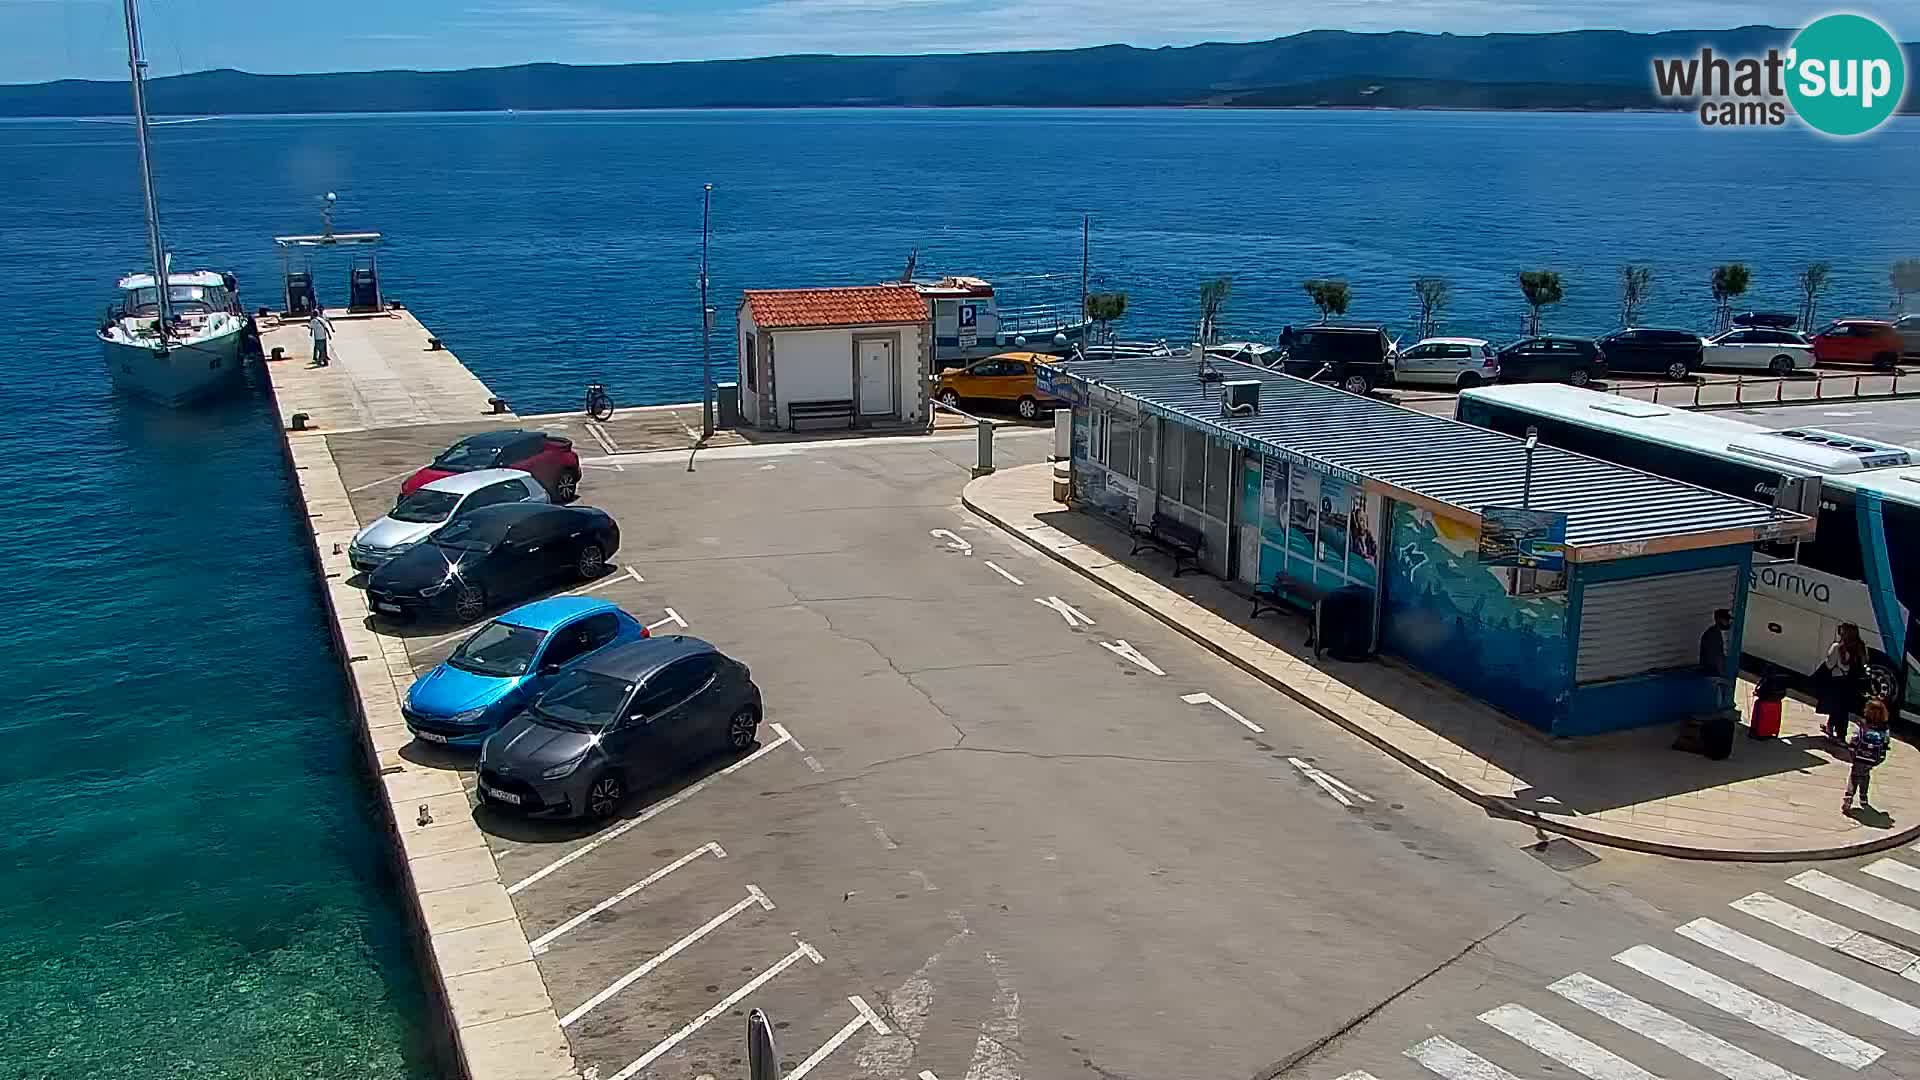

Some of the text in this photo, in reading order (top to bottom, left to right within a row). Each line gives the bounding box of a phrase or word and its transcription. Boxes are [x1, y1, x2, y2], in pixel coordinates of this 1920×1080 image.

[962, 307, 973, 325] P
[1274, 447, 1305, 466] STATION
[1307, 458, 1332, 474] TICKET
[1332, 467, 1359, 485] OFFICE
